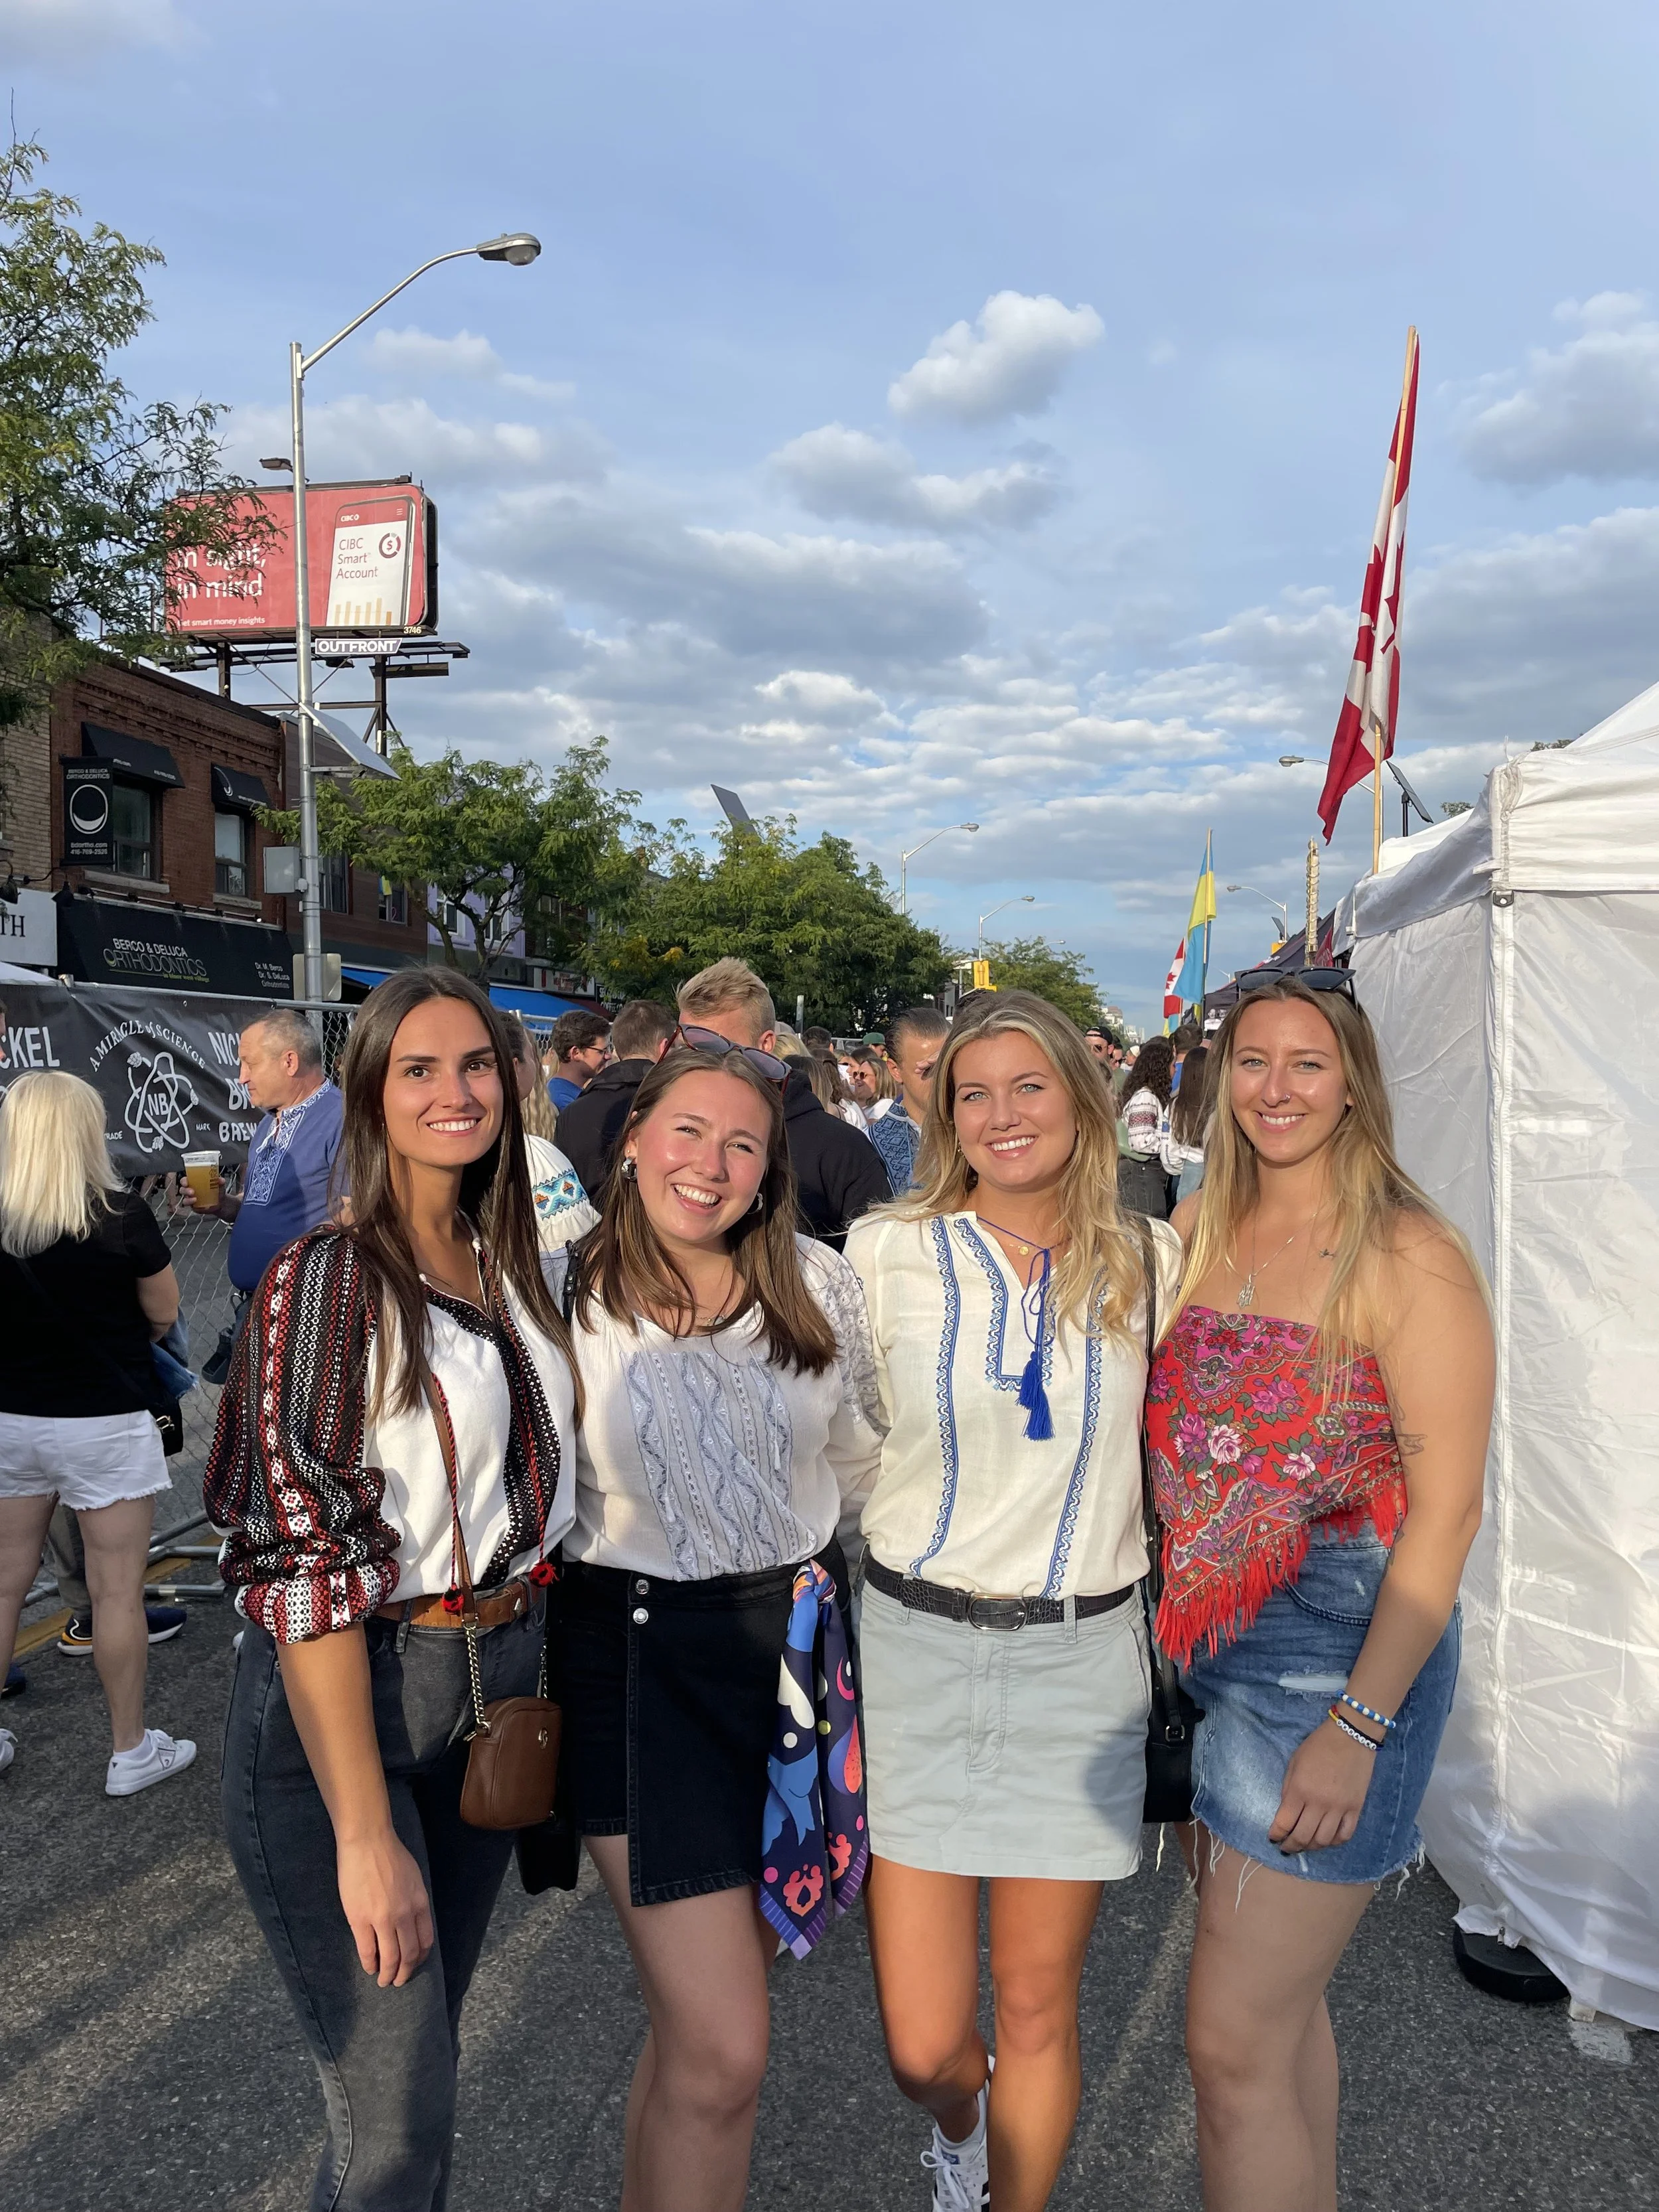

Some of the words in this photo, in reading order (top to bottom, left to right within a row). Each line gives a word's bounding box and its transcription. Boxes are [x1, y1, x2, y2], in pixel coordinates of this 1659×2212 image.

[339, 538, 364, 550] CIBC
[338, 553, 367, 564] Smart
[336, 566, 378, 579] Account
[177, 577, 197, 599] in
[206, 572, 263, 597] mind
[238, 617, 265, 626] insights
[319, 640, 397, 652] OUTFRONT
[113, 938, 145, 952] BERCO
[145, 942, 154, 953] &
[153, 943, 188, 957] DELUCA
[103, 948, 207, 976] ORTHODONTICS
[90, 1057, 100, 1072] A
[95, 1020, 144, 1061] MIRACLE
[145, 1021, 156, 1039] of
[155, 1024, 206, 1069] SCIENCE
[208, 1032, 241, 1066] NIC
[147, 1093, 170, 1116] NB
[104, 1130, 123, 1140] TRADE
